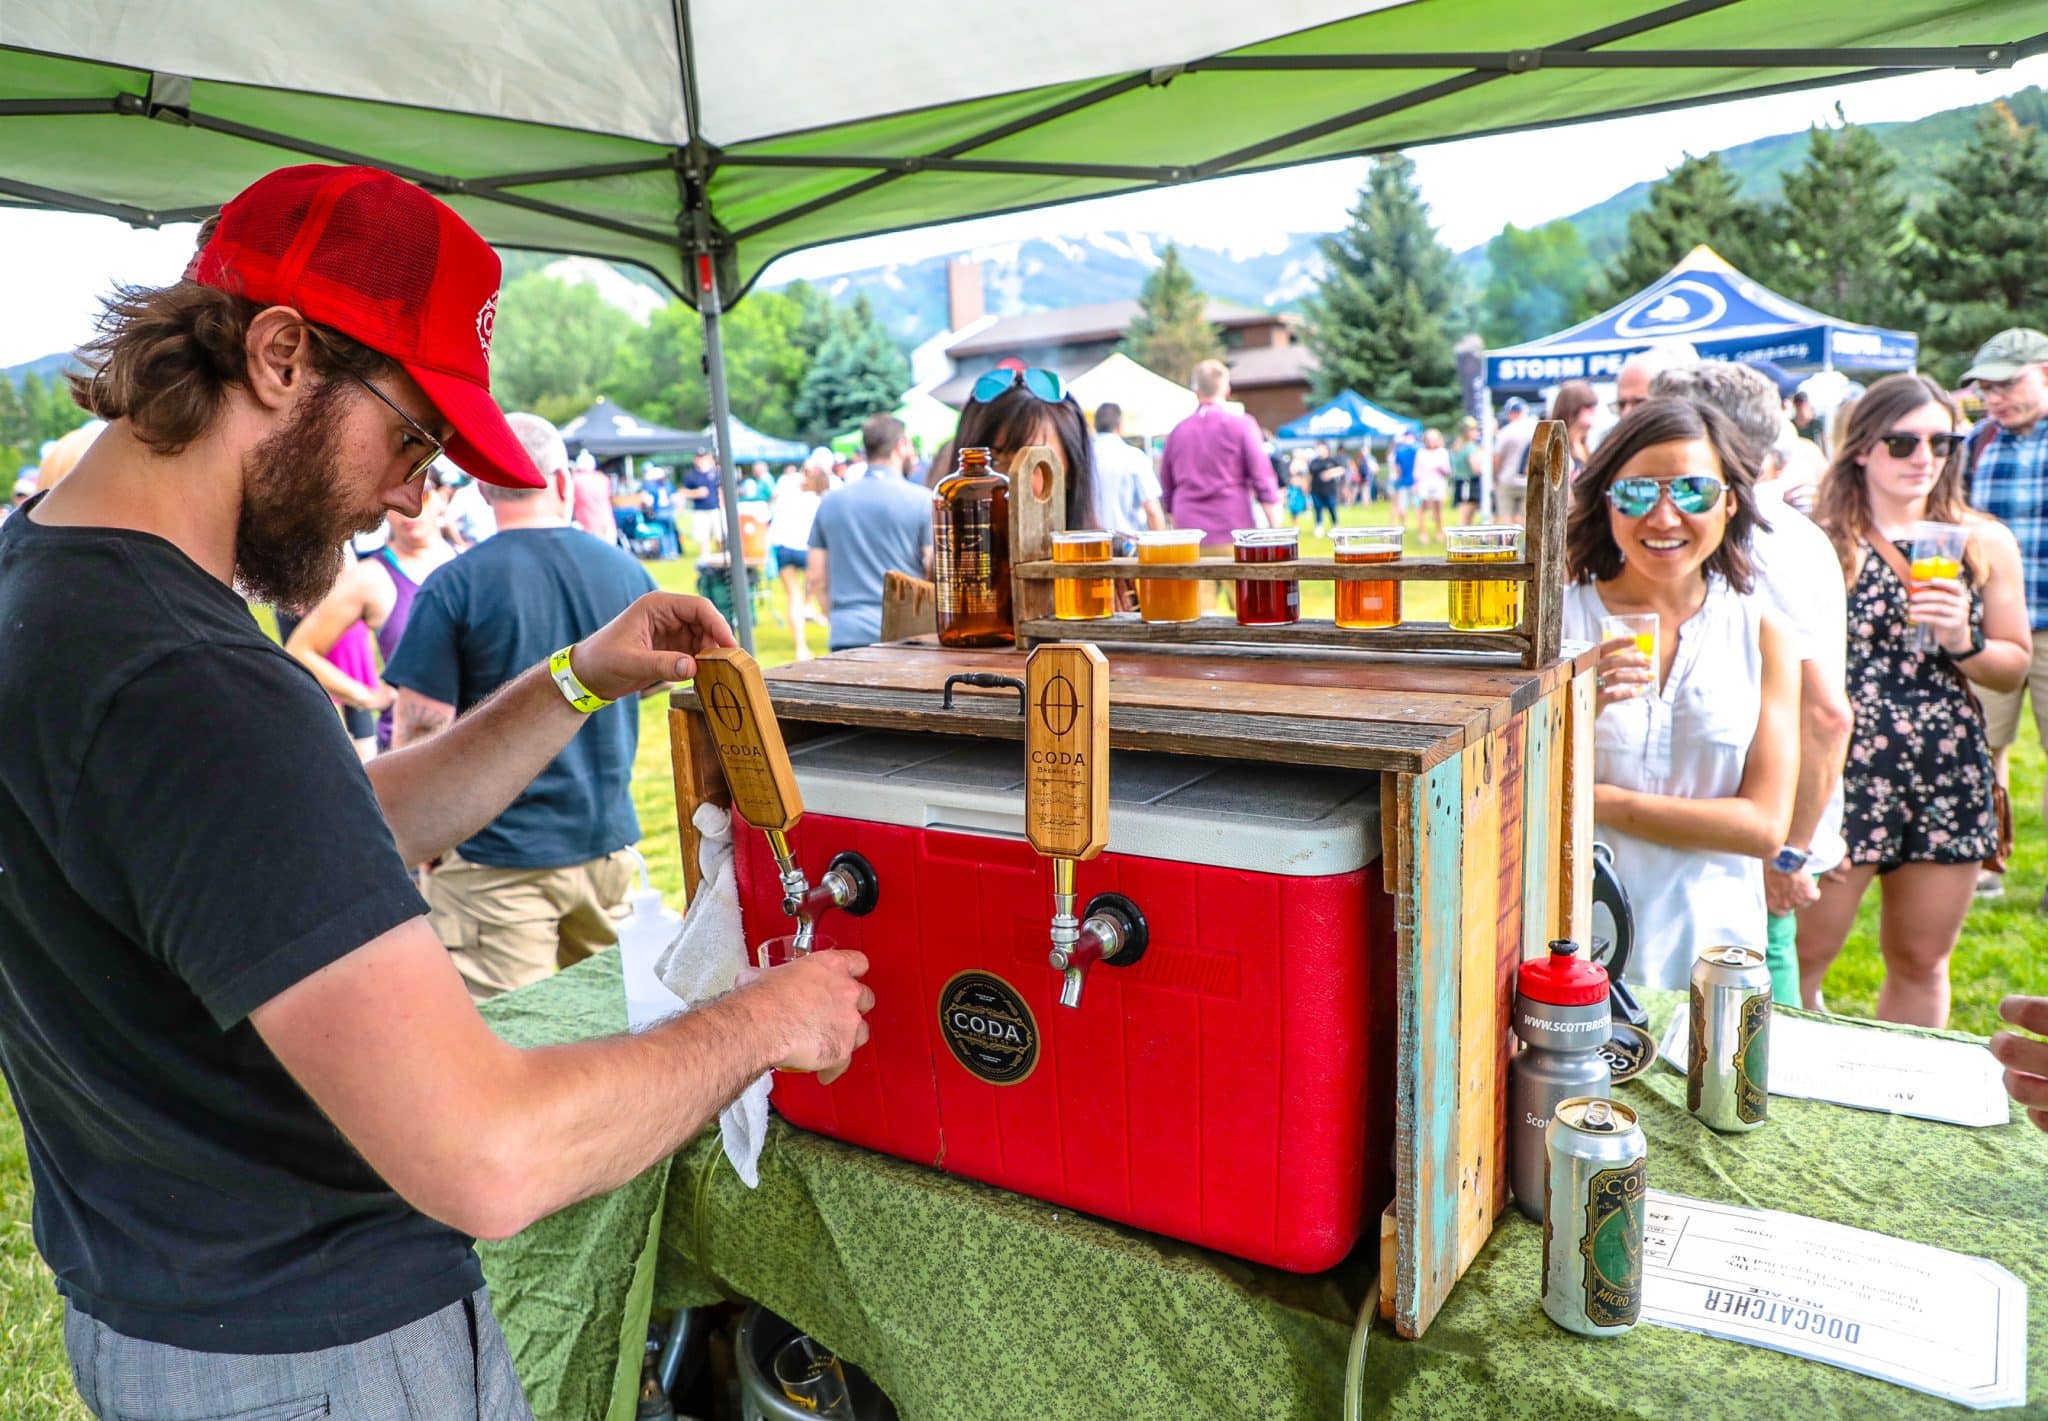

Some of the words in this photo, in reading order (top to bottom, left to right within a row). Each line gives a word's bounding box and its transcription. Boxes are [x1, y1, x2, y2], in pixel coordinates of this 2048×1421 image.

[1498, 354, 1584, 380] STORM
[720, 743, 763, 757] CODA
[1031, 750, 1086, 767] CODA
[954, 1012, 1022, 1044] CODA
[1596, 1288, 1629, 1307] MICRO
[1747, 1287, 1782, 1299] ALE
[1703, 1289, 1861, 1345] DOGCATCHER
